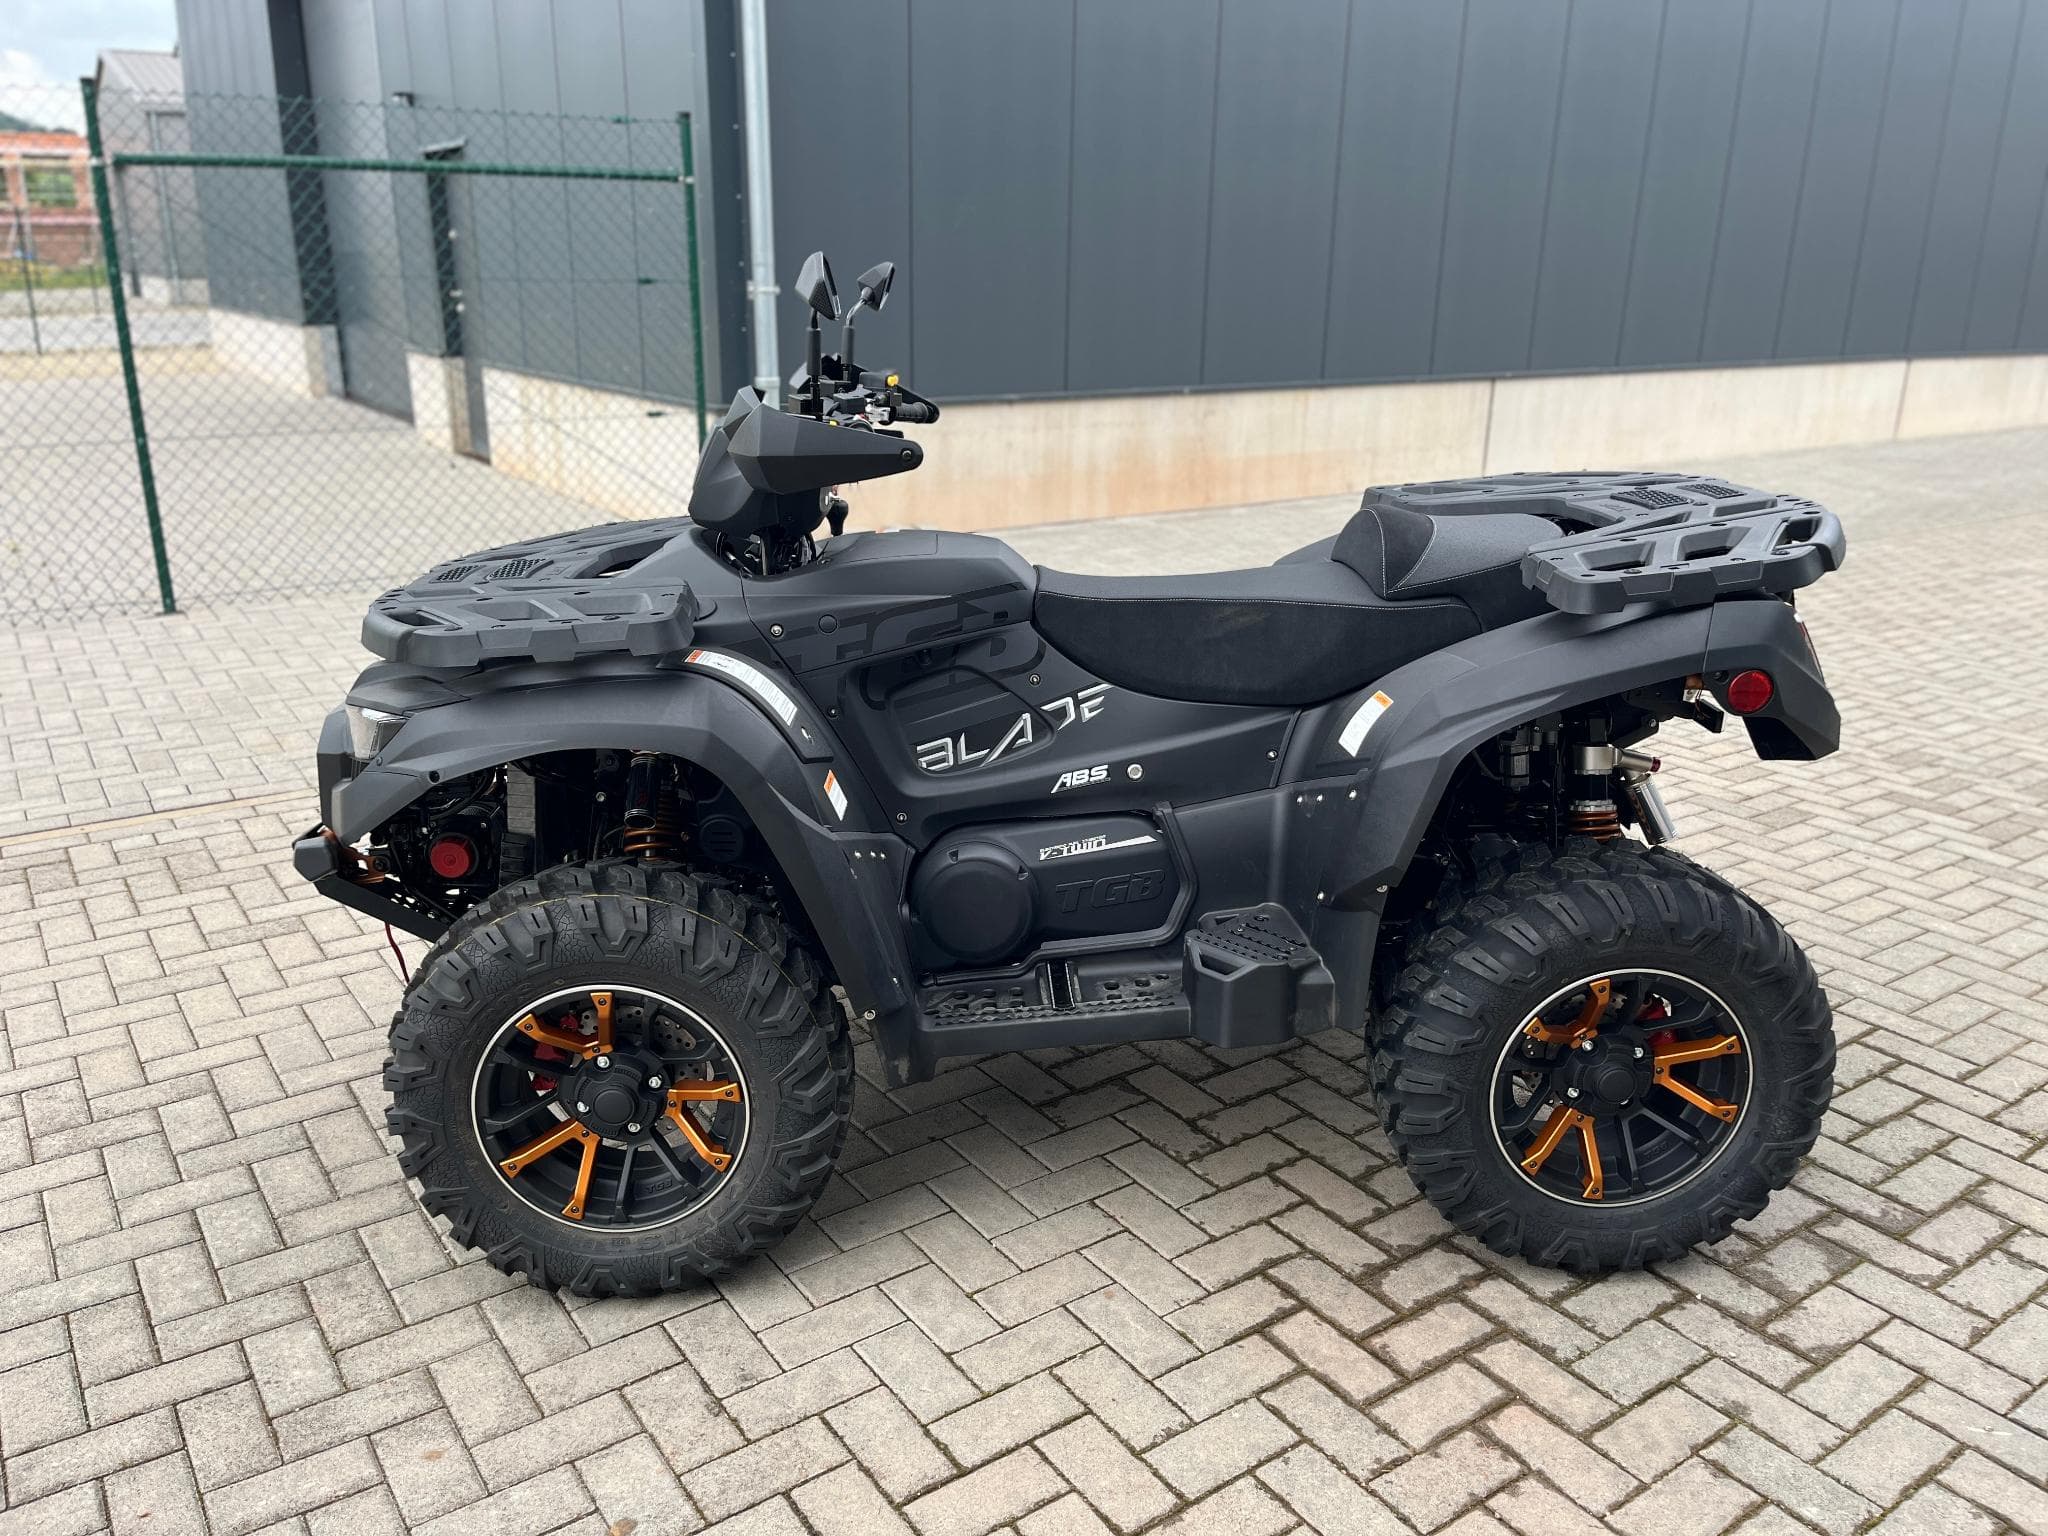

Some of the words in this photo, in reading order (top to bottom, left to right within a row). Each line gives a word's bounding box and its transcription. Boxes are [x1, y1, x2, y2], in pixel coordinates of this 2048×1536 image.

[916, 683, 1115, 772] BLADE
[1050, 764, 1109, 794] ABS
[1055, 868, 1166, 914] TGB
